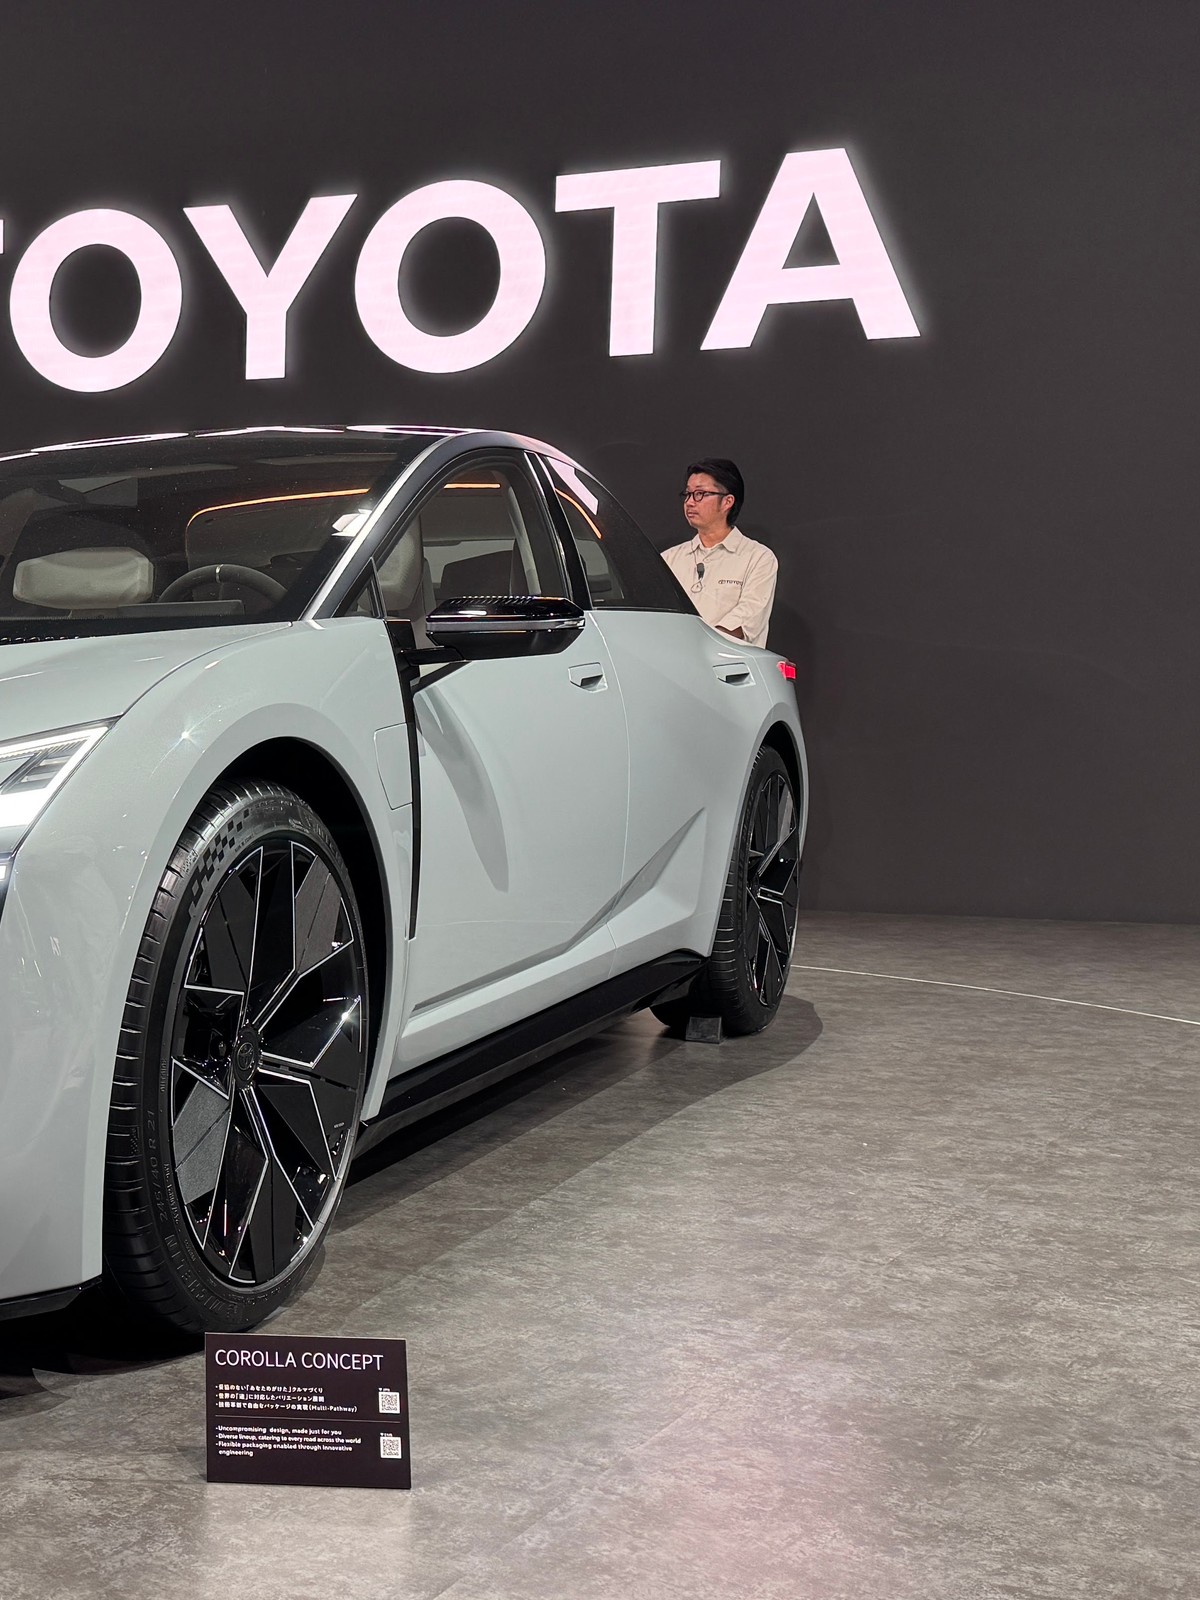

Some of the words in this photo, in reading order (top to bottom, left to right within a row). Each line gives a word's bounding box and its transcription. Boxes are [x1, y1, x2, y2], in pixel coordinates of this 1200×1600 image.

[147, 1110, 156, 1131] 21
[150, 1157, 168, 1221] 245/40
[164, 1234, 226, 1312] MICHELIN
[215, 1349, 297, 1368] COROLLA
[301, 1352, 384, 1371] CONCEPT
[238, 1433, 258, 1441] lineup,
[269, 1427, 290, 1435] design,
[218, 1449, 254, 1457] engineering
[241, 1442, 272, 1450] packaging
[298, 1444, 322, 1452] through
[322, 1444, 353, 1452] innovative
